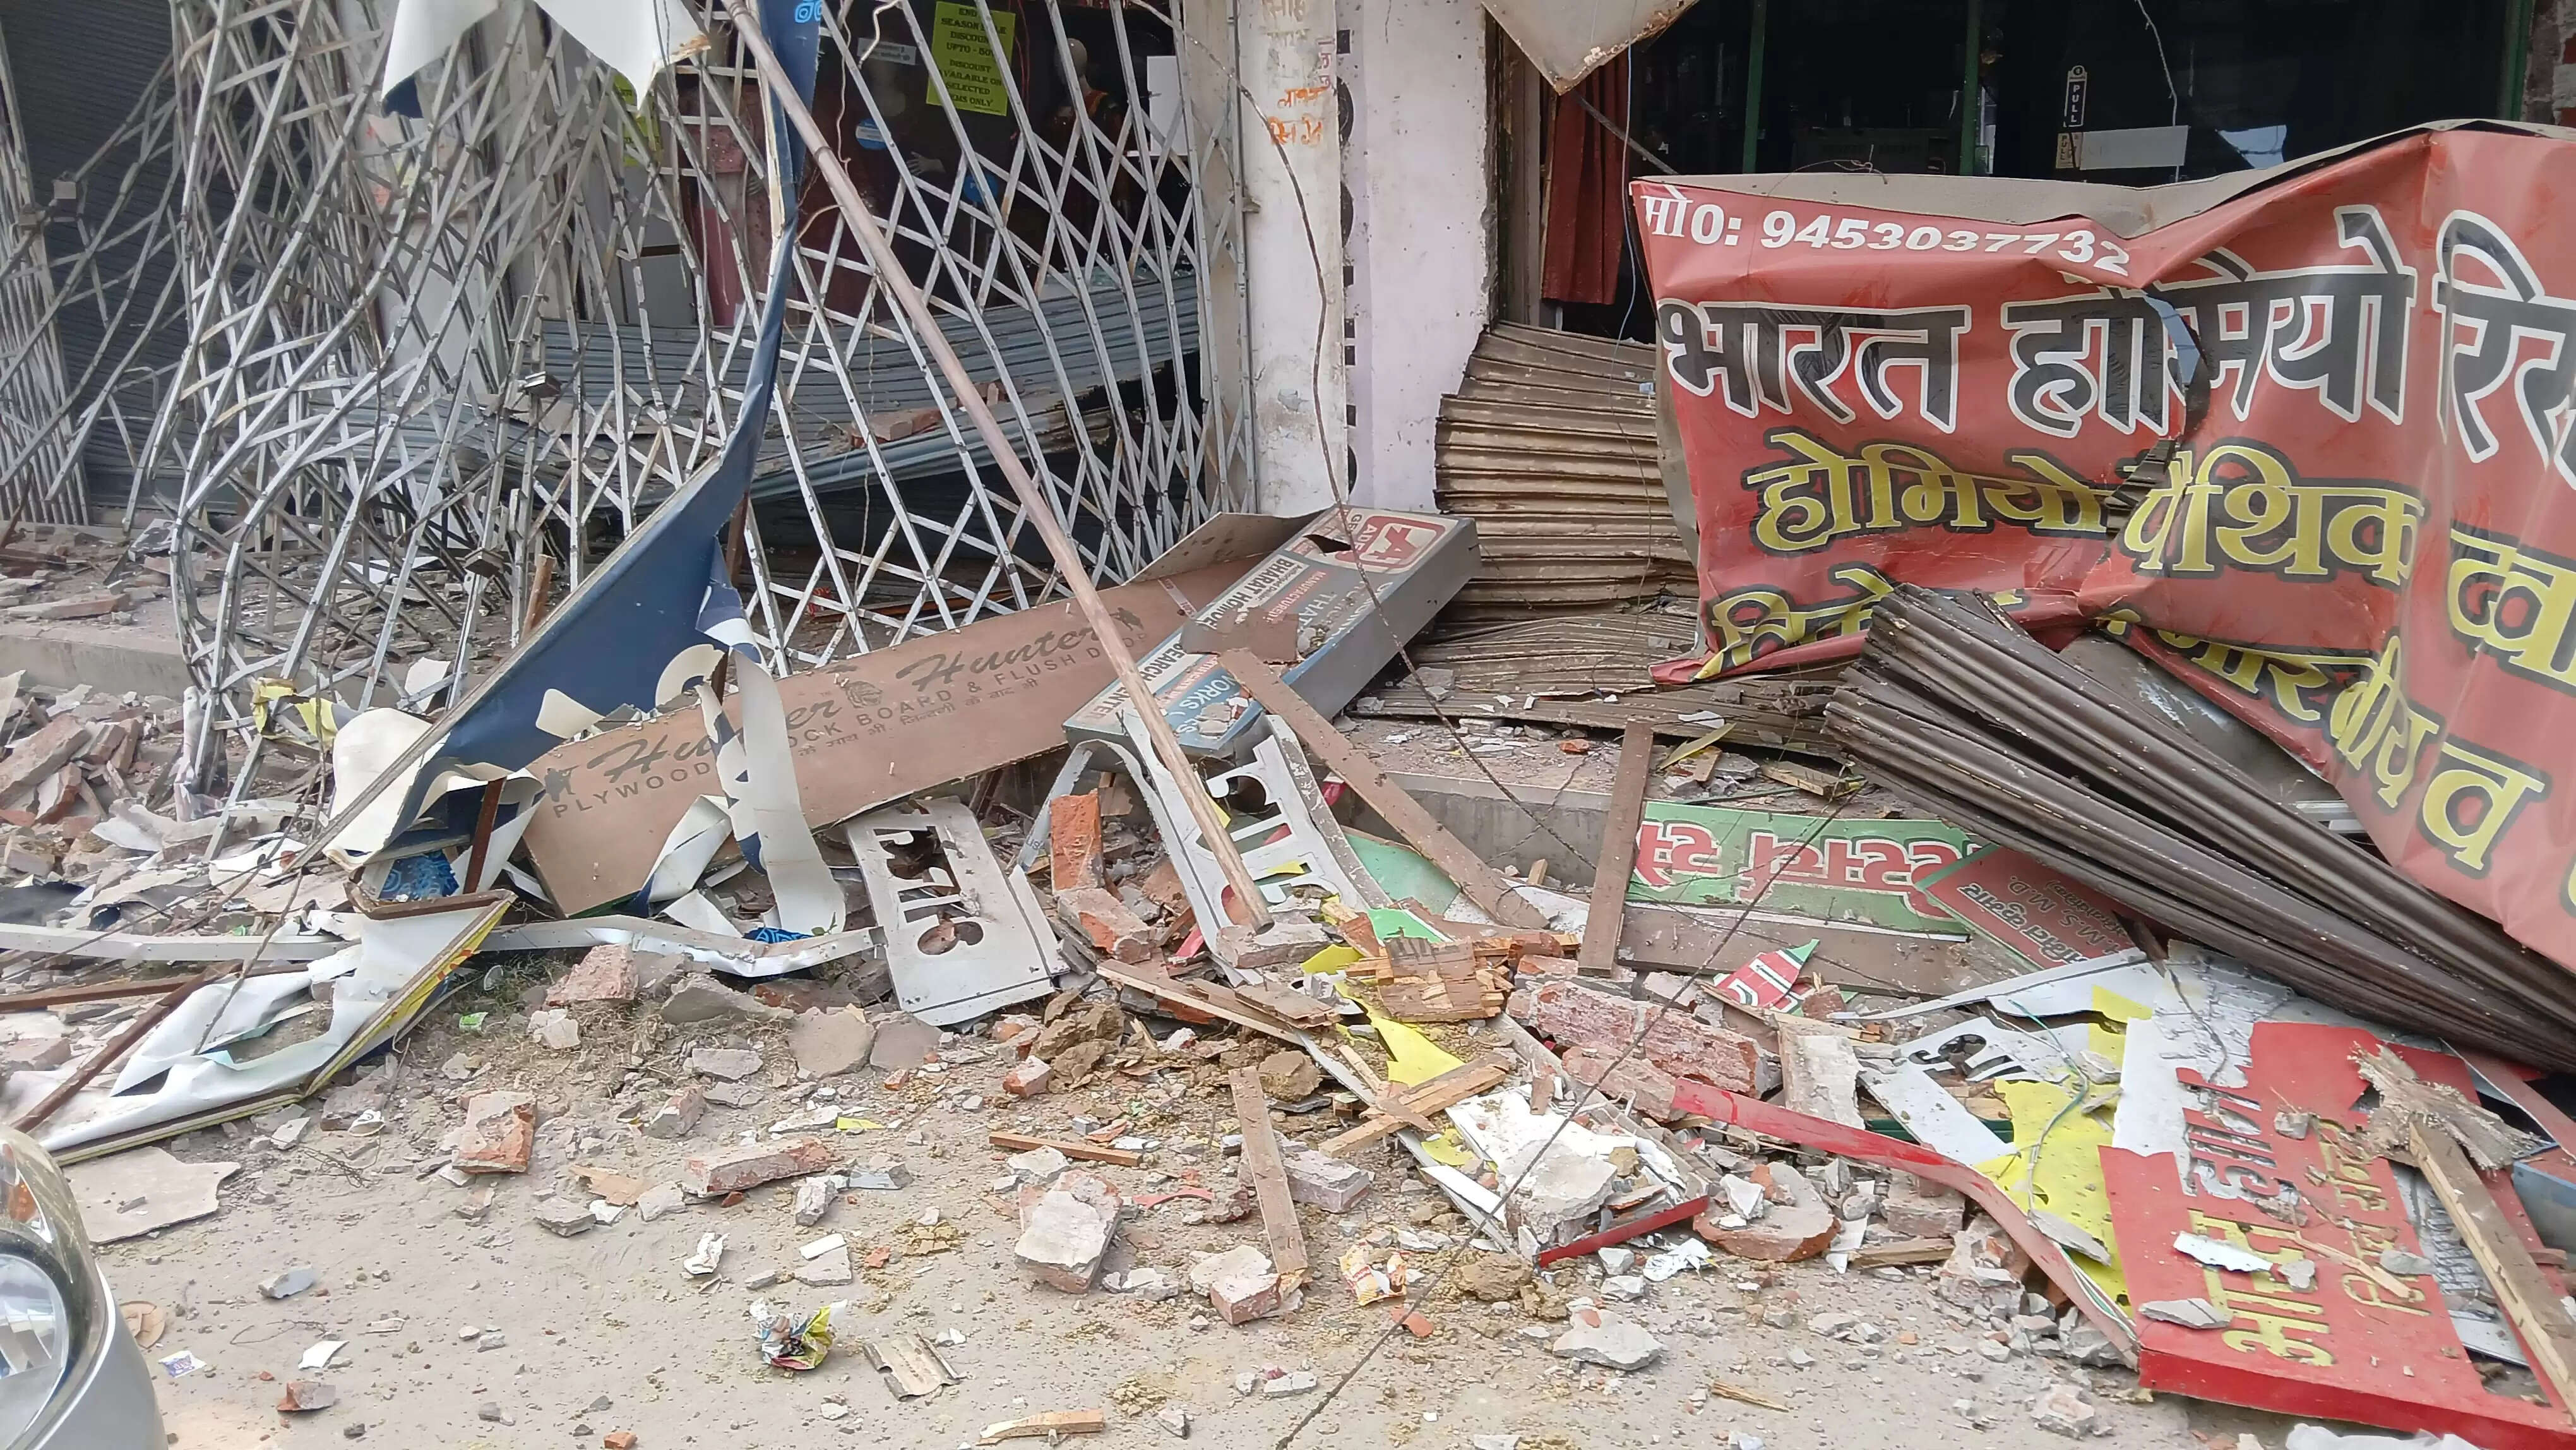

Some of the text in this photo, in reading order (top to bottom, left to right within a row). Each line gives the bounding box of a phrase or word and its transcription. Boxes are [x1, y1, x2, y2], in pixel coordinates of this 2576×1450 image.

[950, 31, 989, 44] DISCOUN
[949, 59, 992, 73] DISCOUNT
[969, 98, 994, 107] ONLY
[2070, 84, 2080, 123] PULL
[1760, 210, 2130, 277] 9453037732
[1658, 297, 1972, 434] भारत
[1243, 556, 1294, 595] BHARAT
[1203, 590, 1250, 629] HOMOE
[1086, 685, 1131, 721] ENTER
[554, 760, 711, 818] PLYWOOD
[856, 688, 952, 728] BOARD
[967, 679, 982, 693] &
[994, 652, 1076, 685] FLUSH
[587, 700, 842, 783] Huer
[1957, 882, 2028, 930] कुमार
[2008, 875, 2056, 913] M.D.
